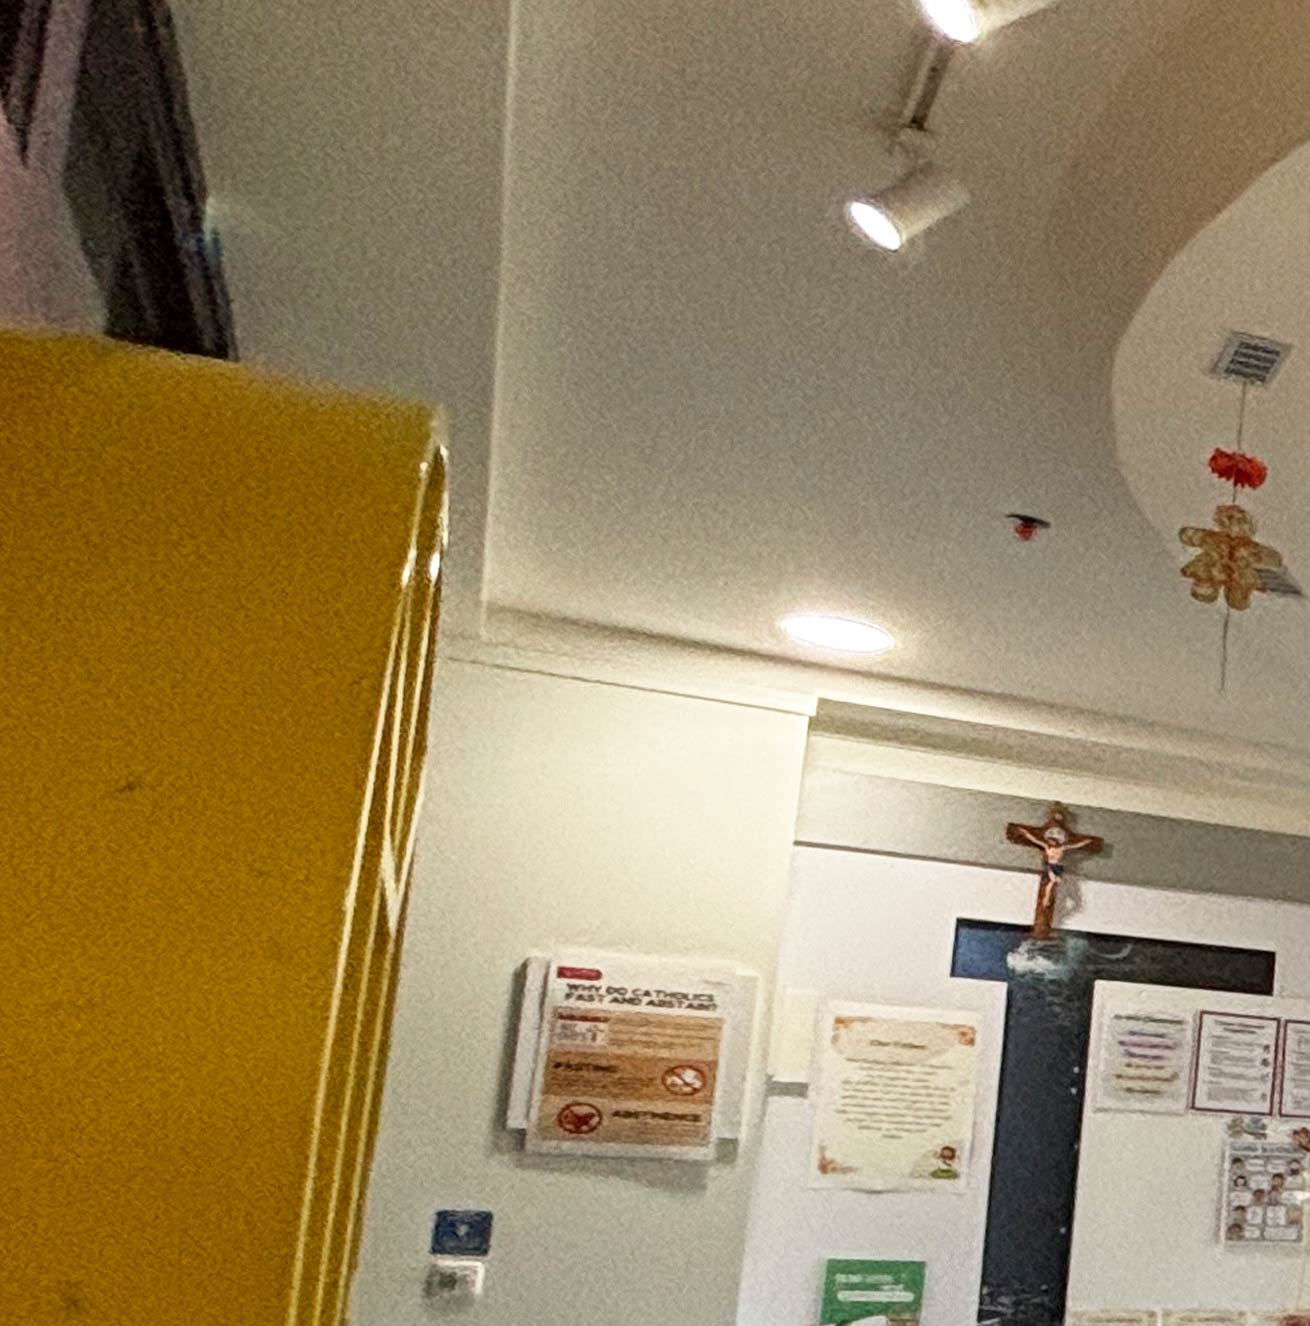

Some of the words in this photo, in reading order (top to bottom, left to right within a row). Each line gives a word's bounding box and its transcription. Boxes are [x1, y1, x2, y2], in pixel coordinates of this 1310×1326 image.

[565, 992, 604, 1003] FAST
[608, 996, 642, 1006] AND
[566, 983, 602, 993] WHY
[606, 986, 628, 996] DO
[632, 988, 714, 1002] CATHOLICS
